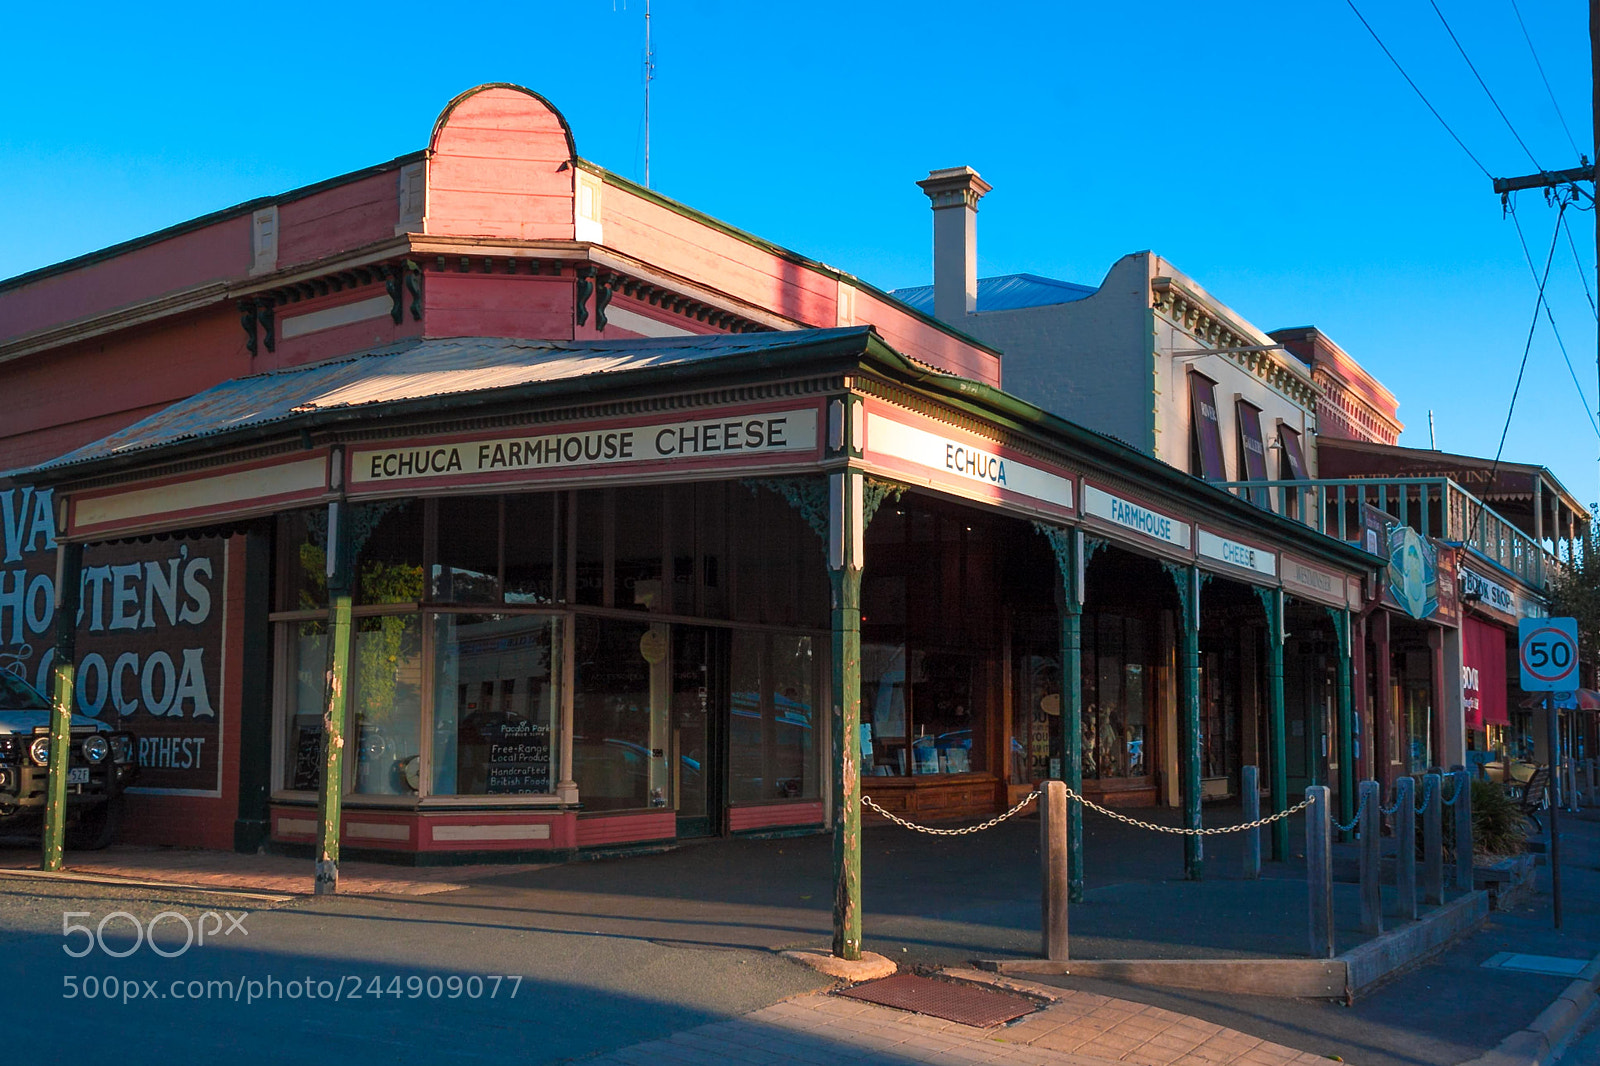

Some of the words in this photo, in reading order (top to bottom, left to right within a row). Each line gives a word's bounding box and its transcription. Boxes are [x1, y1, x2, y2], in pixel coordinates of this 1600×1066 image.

[370, 447, 462, 478] ECHUCA
[478, 431, 634, 469] FARMHOUSE
[655, 417, 788, 455] CHEESE
[1466, 470, 1497, 482] INN
[946, 443, 1007, 486] ECHUCA
[1111, 499, 1171, 540] FARMHOUSE
[1222, 541, 1255, 568] CHEESE
[0, 486, 58, 563] VA
[0, 544, 212, 645] HOTEN'S
[1531, 641, 1570, 668] 50
[531, 723, 550, 732] Park
[491, 744, 549, 754] Free-Range
[491, 753, 517, 762] Local
[490, 766, 547, 776] Handcrafted
[490, 777, 520, 786] British
